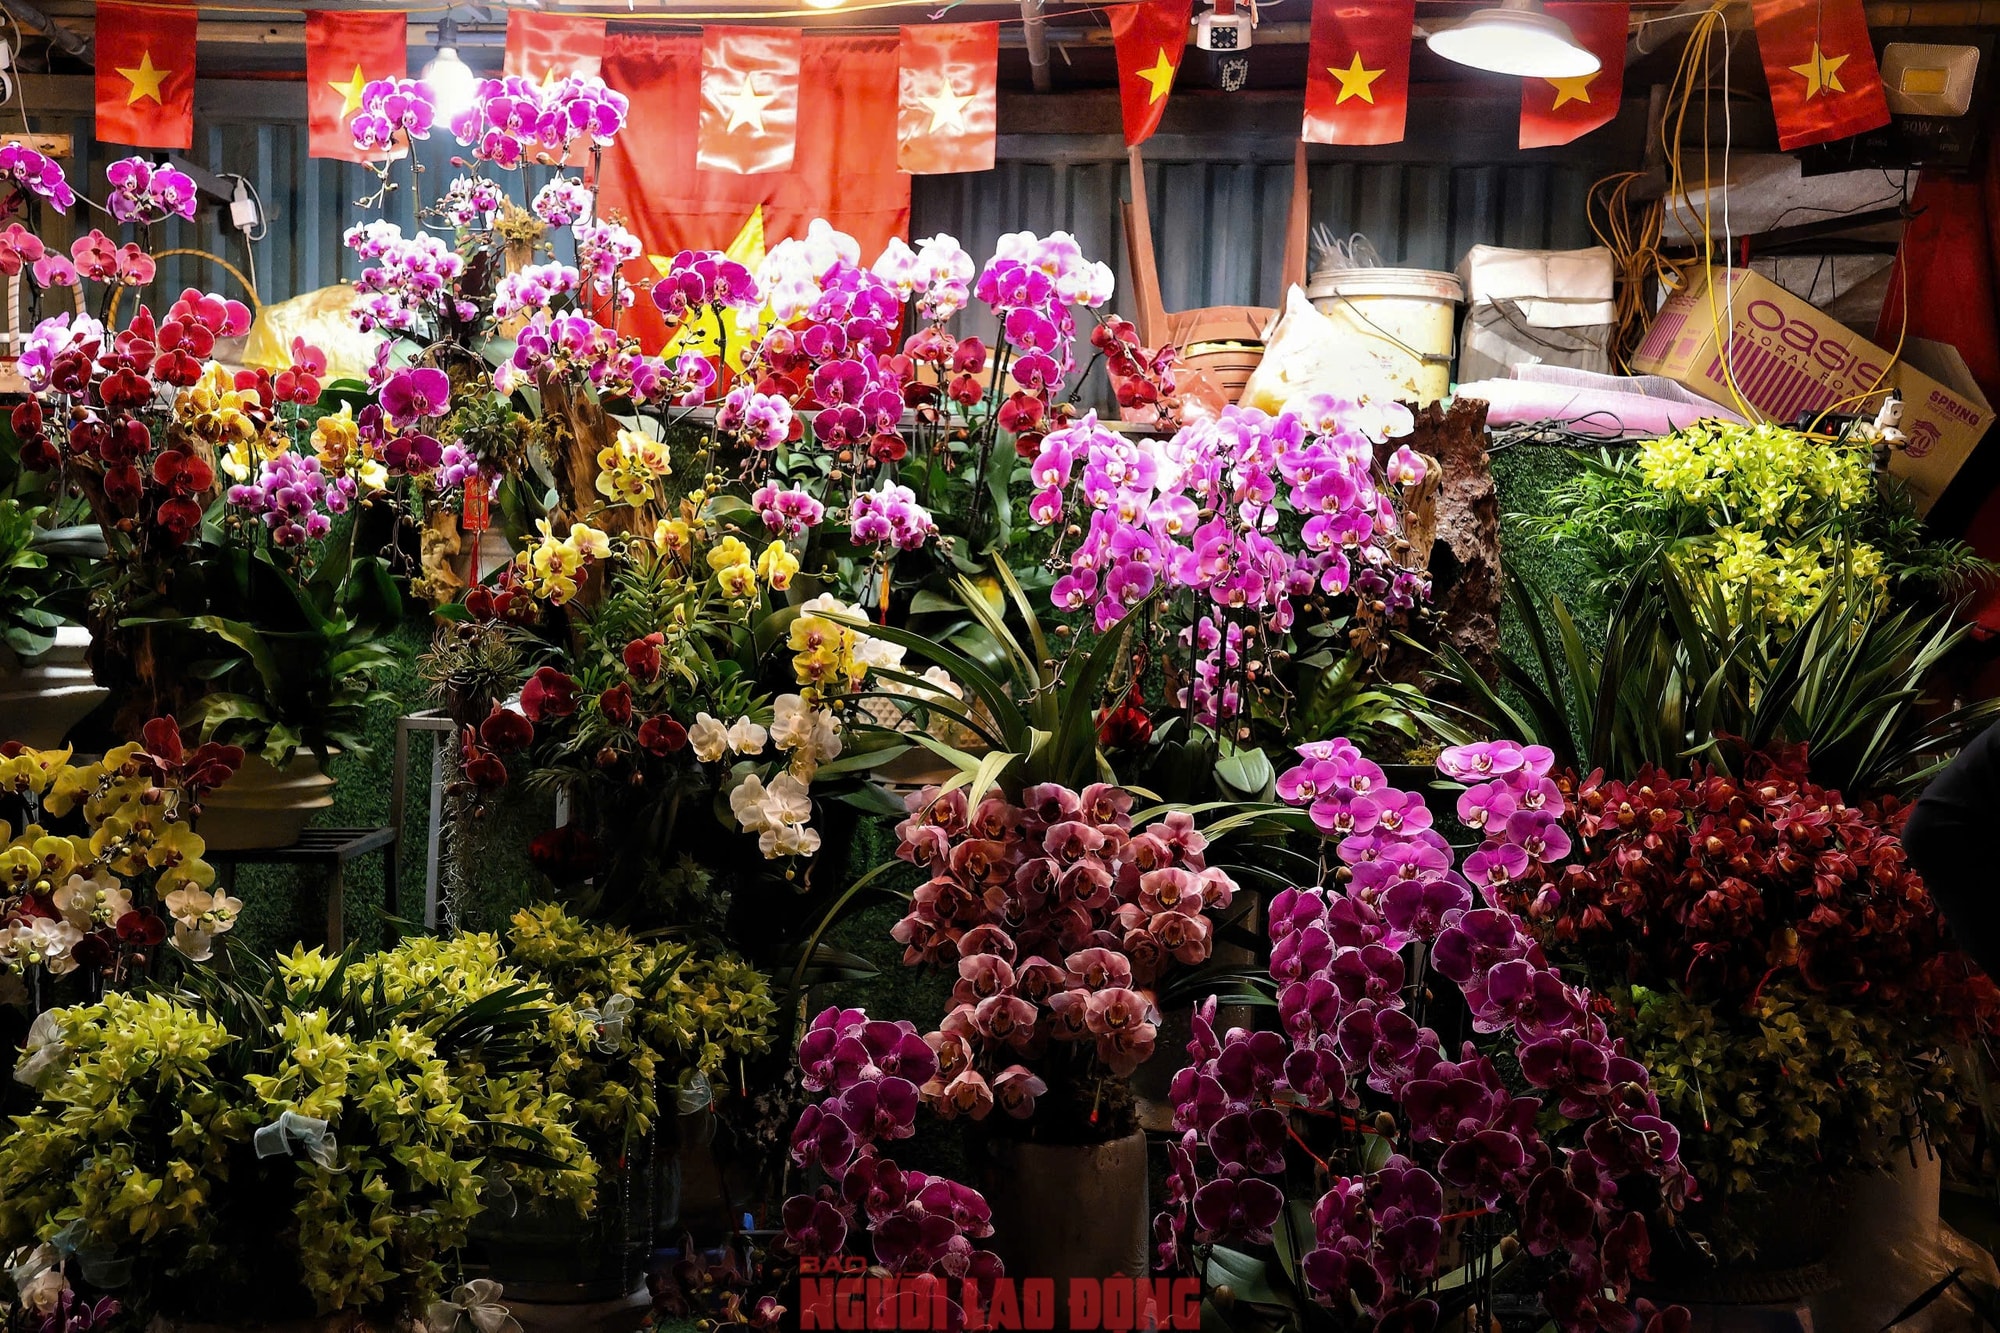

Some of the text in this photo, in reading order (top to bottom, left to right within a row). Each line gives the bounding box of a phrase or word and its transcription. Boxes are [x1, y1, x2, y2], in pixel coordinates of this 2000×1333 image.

[1735, 320, 1874, 409] FLORAL FOAM
[1929, 390, 1980, 426] SPRING
